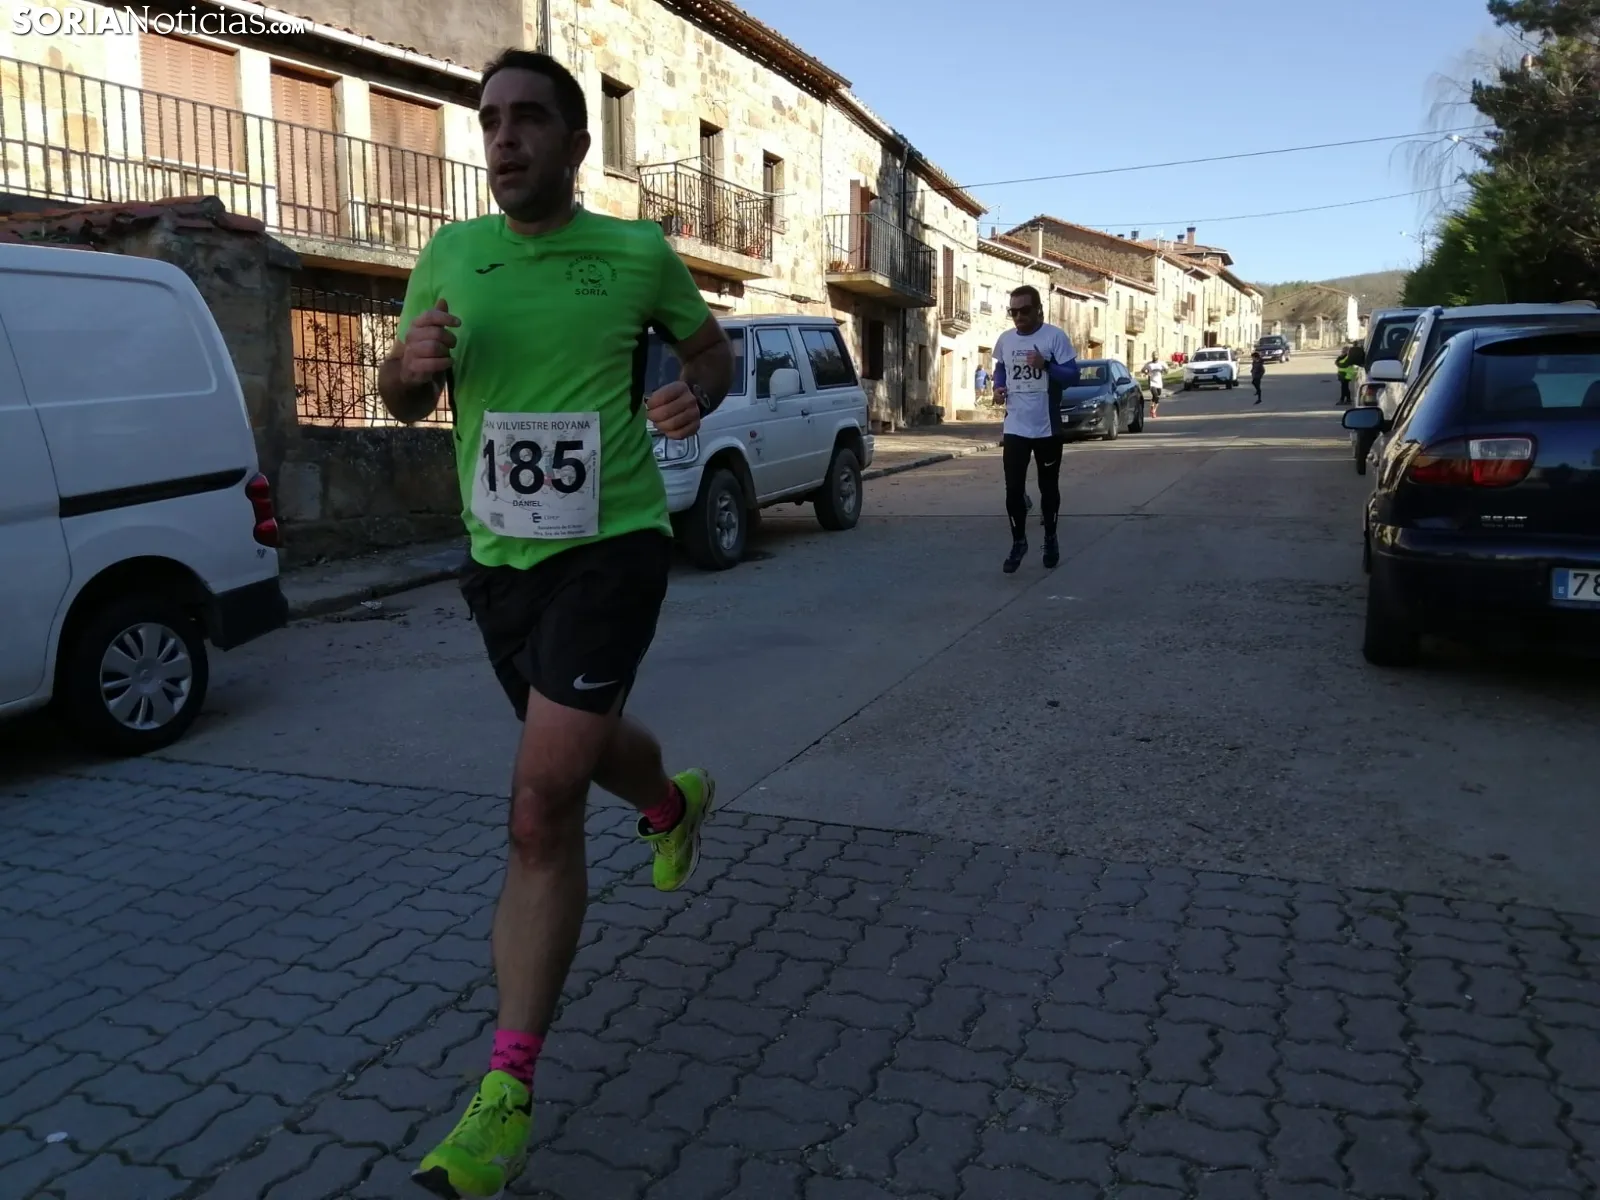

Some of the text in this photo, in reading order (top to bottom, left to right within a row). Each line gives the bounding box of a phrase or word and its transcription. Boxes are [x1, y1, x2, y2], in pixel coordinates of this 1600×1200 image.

[574, 288, 608, 297] SORIA
[1012, 365, 1042, 380] 230
[496, 420, 549, 430] VILVIESTRE
[551, 420, 591, 430] ROYANA
[483, 439, 587, 495] 185
